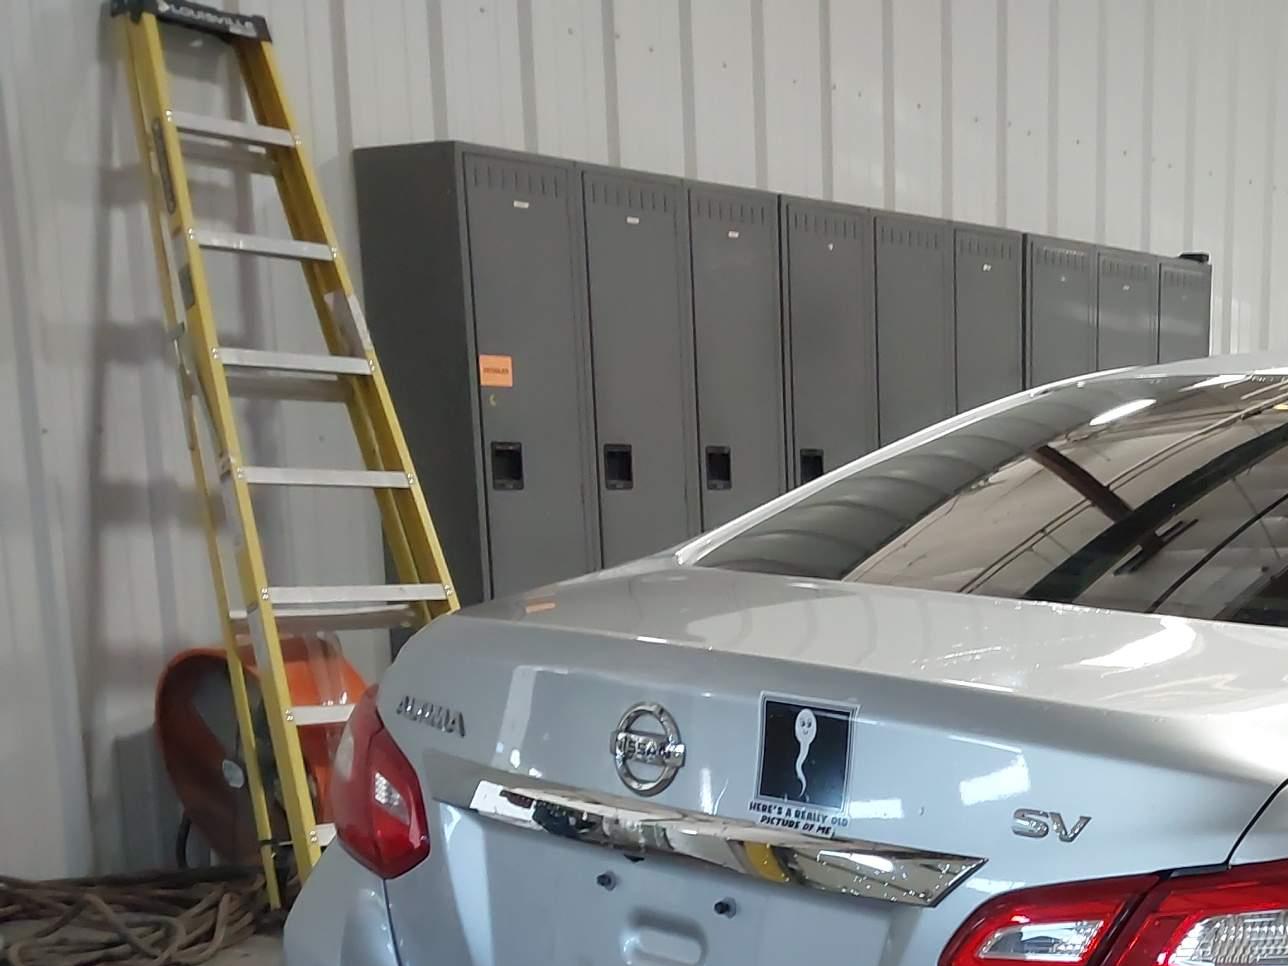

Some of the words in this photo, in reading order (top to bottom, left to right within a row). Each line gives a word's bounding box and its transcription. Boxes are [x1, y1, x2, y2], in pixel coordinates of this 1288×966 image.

[749, 801, 782, 815] HERE'S
[785, 808, 792, 818] A
[794, 810, 828, 822] REALLY
[831, 817, 848, 827] OLD
[760, 815, 800, 829] PICTURE
[802, 822, 815, 832] OF
[816, 826, 832, 835] ME
[1013, 808, 1091, 843] SV
